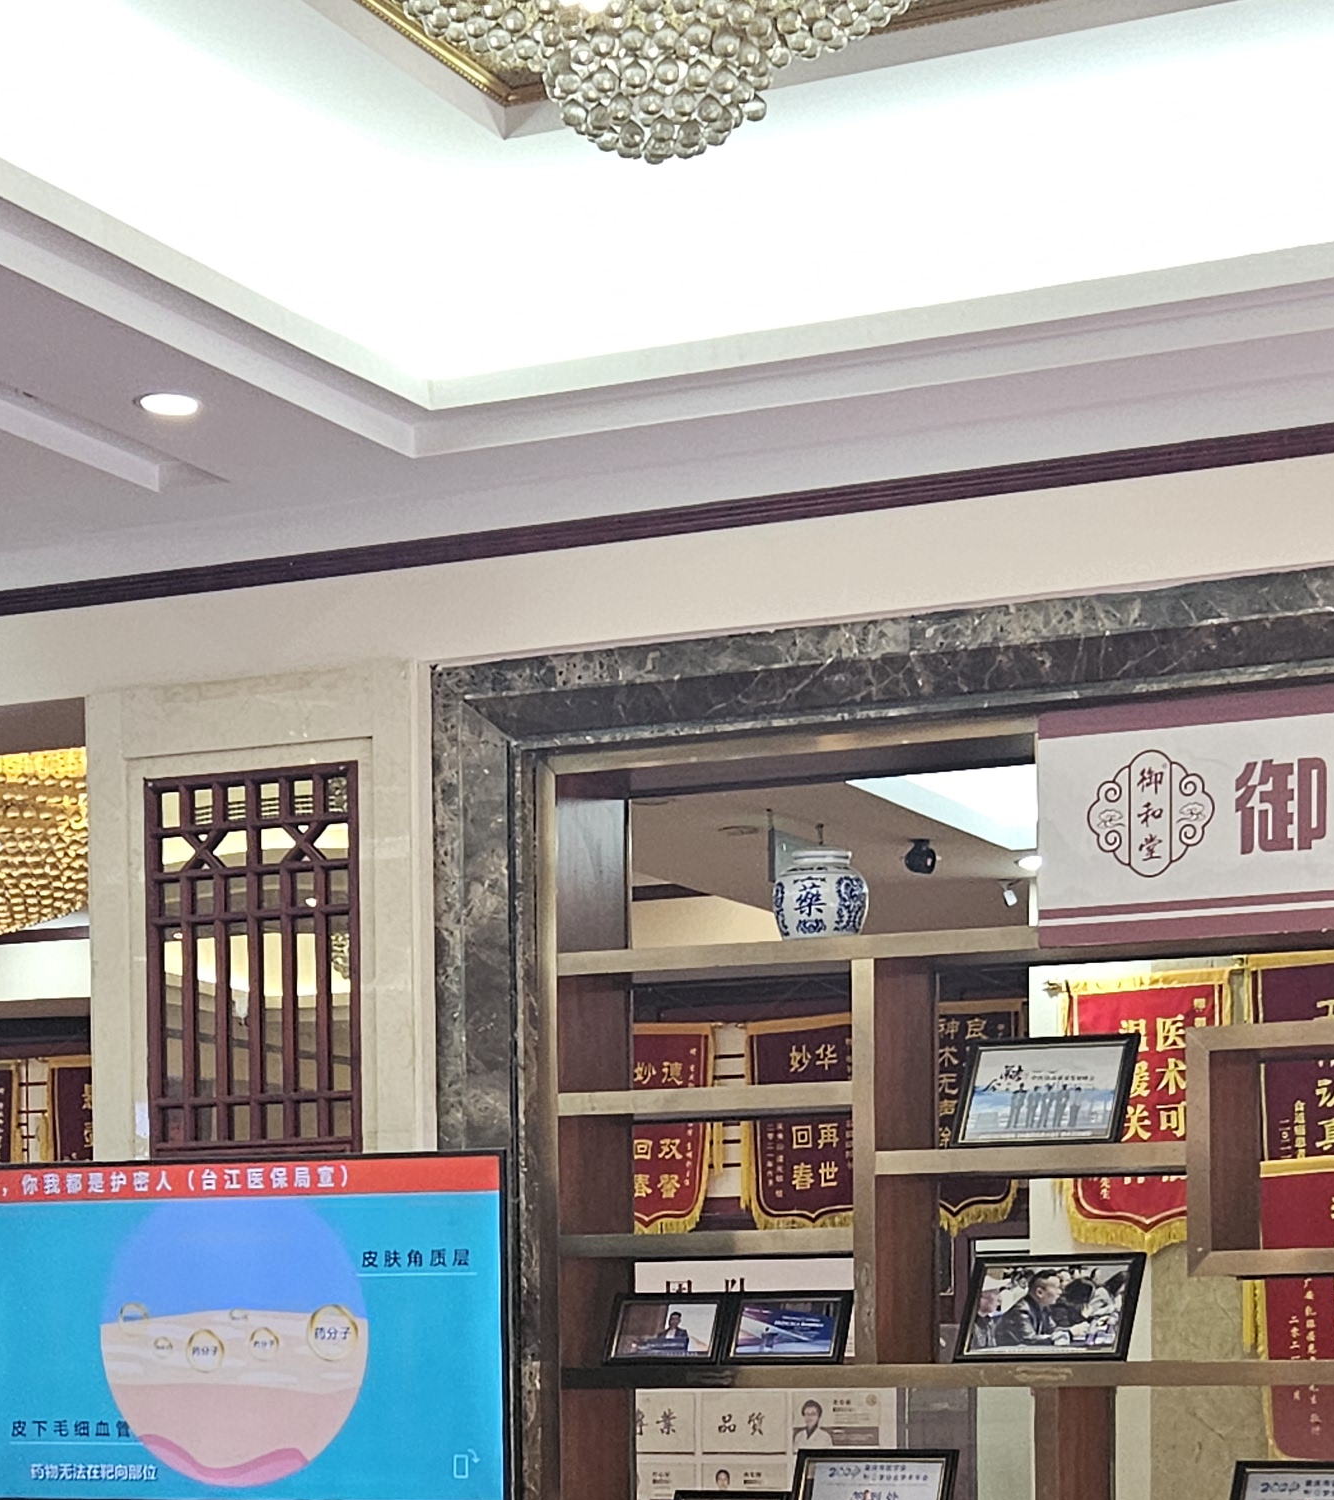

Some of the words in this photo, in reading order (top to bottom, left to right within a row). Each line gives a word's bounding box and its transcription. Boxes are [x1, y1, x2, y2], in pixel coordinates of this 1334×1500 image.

[1137, 764, 1165, 863] 御和堂
[658, 1061, 683, 1199] 德双馨
[789, 1044, 815, 1190] 妙回春
[815, 1044, 839, 1187] 华再世
[361, 1248, 470, 1269] 皮肤角质层
[314, 1326, 352, 1342] 药分子
[11, 1419, 131, 1439] 皮下毛细血管
[30, 1463, 158, 1482] 药物无法在靶向部位
